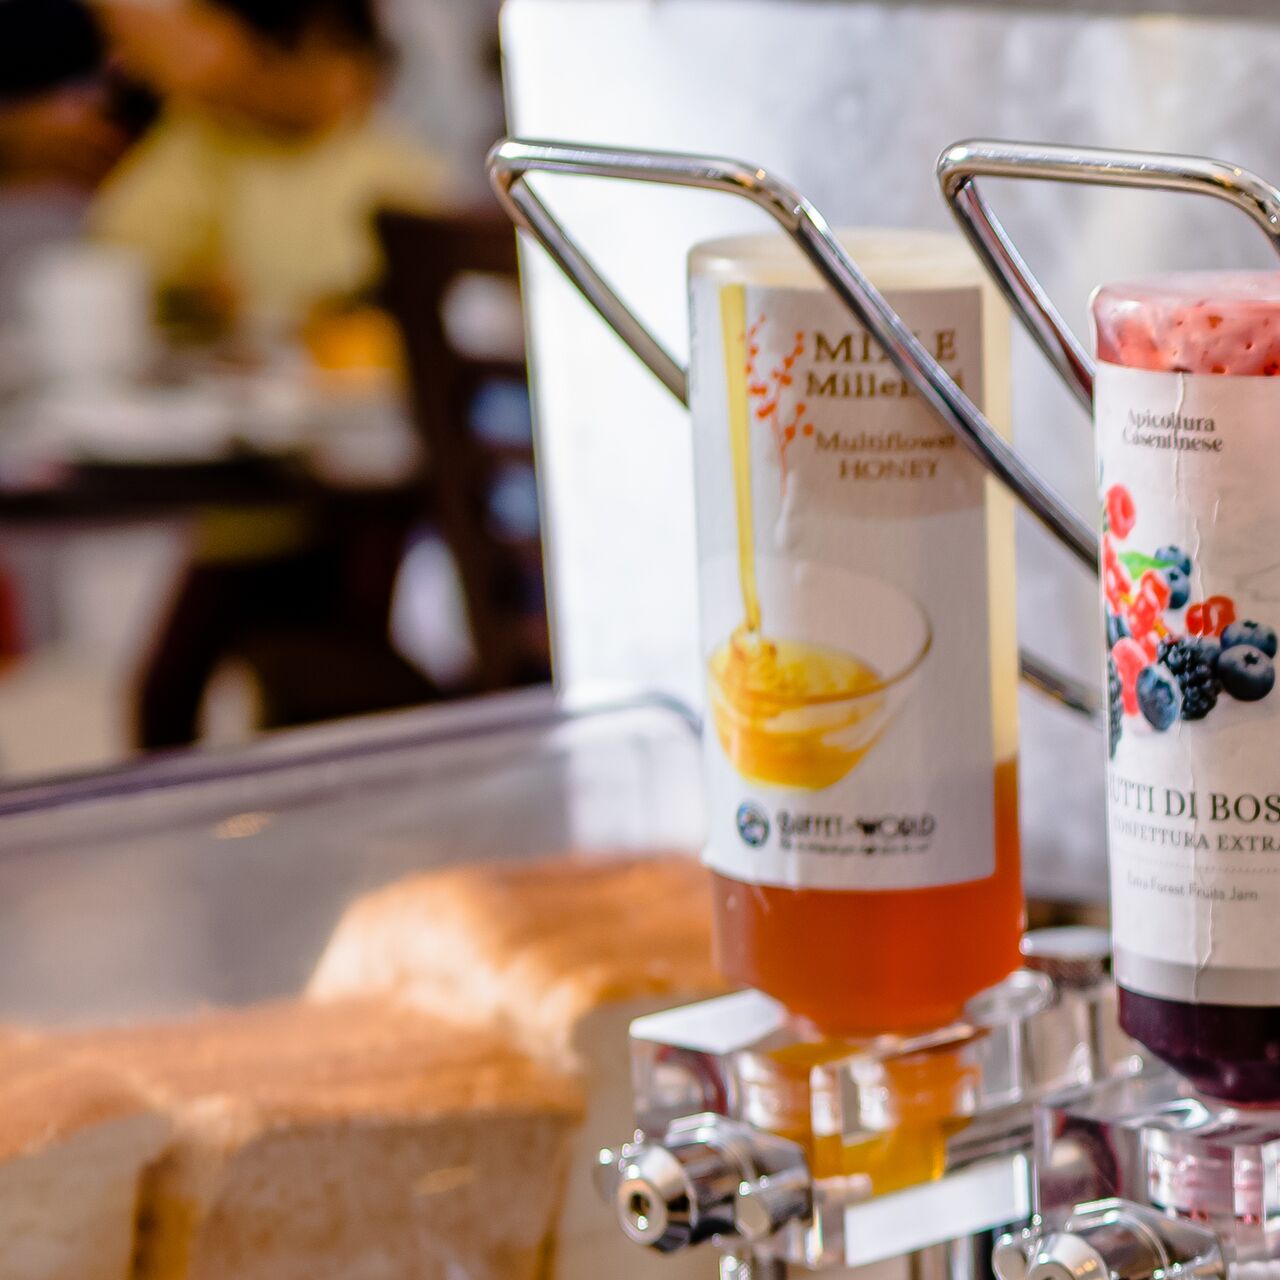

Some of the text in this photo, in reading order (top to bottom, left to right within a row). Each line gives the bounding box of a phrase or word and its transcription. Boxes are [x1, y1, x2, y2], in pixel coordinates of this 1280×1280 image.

[814, 330, 957, 364] MIE
[838, 458, 939, 480] HONEY
[1164, 787, 1199, 821] DI
